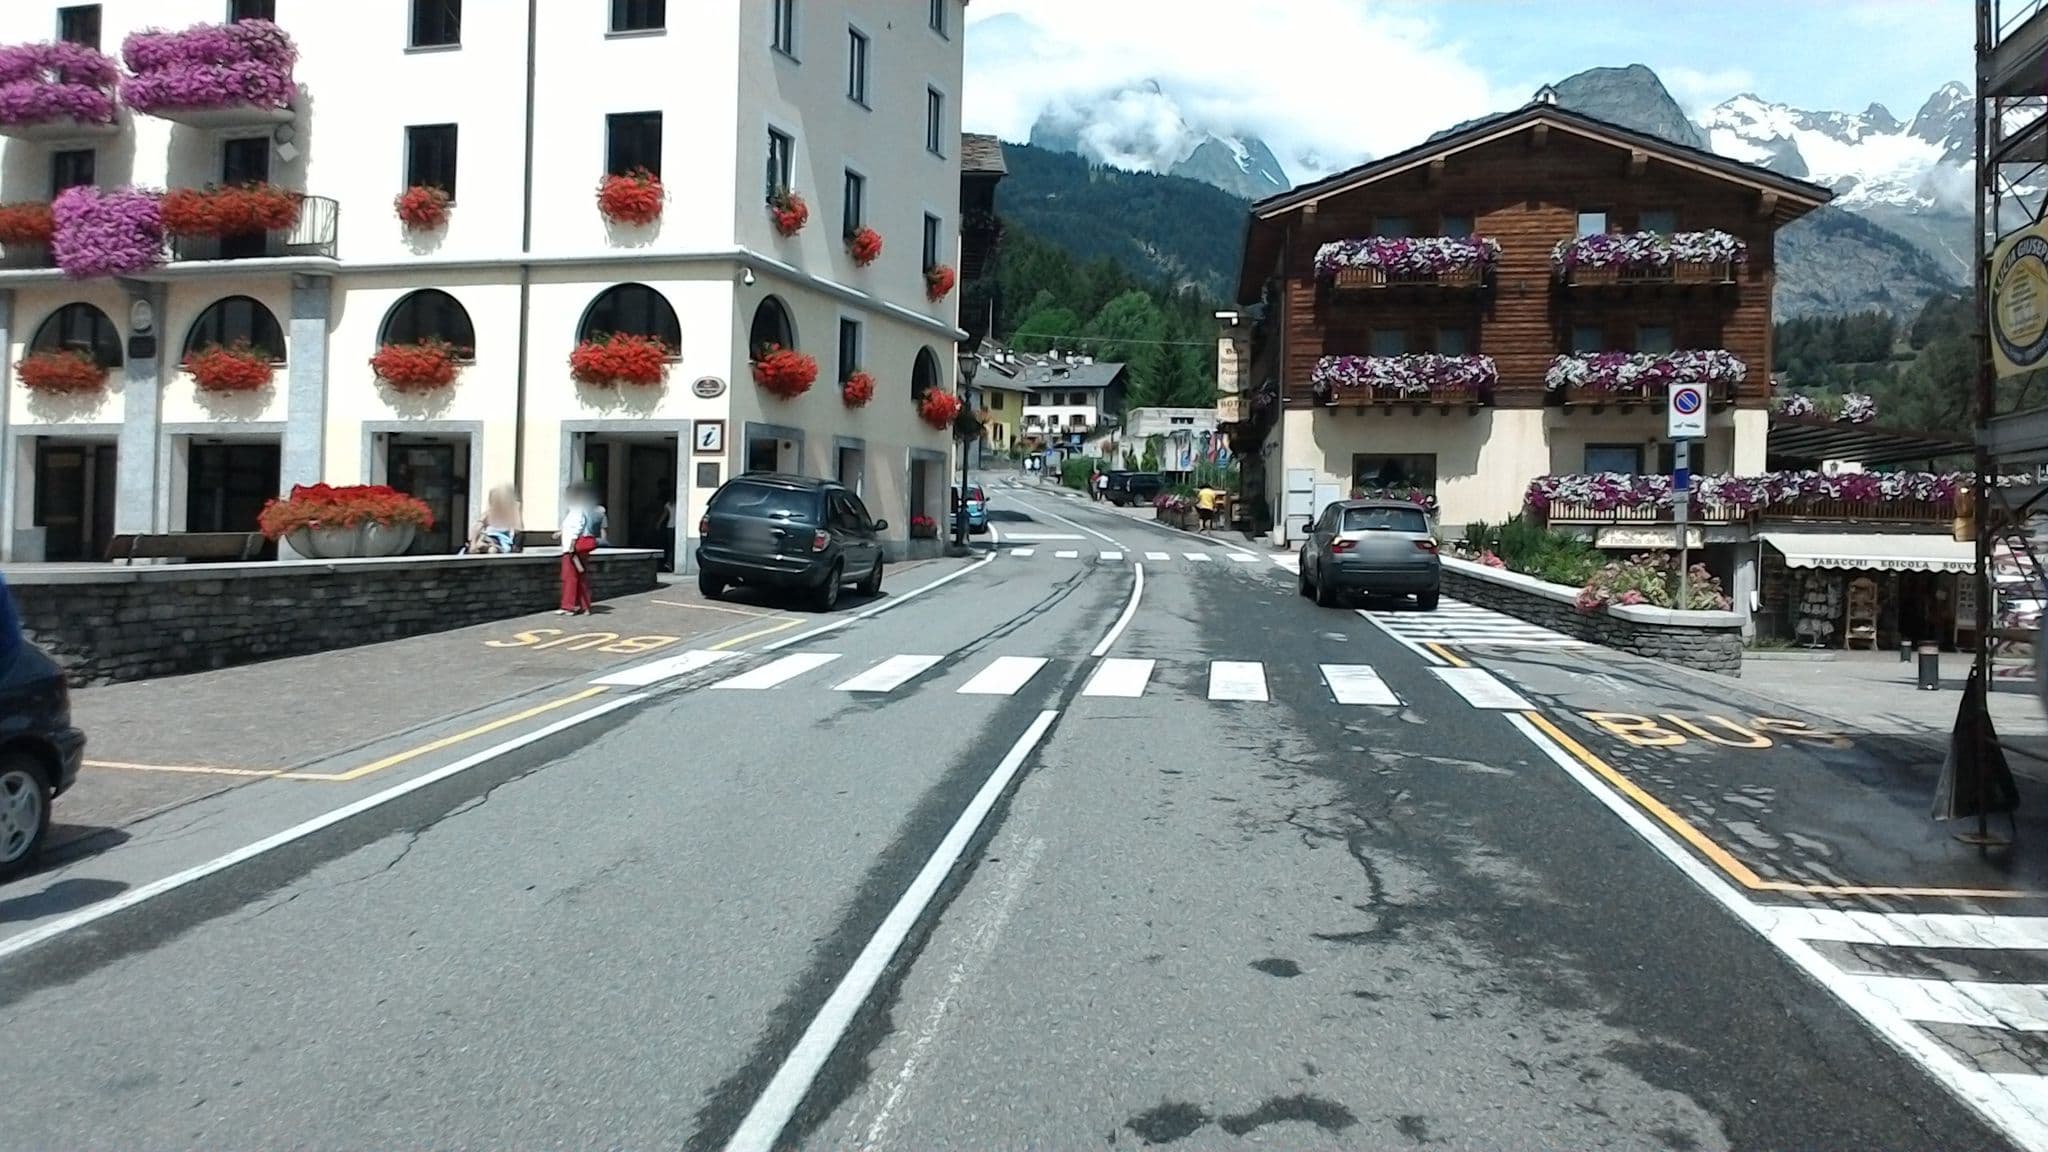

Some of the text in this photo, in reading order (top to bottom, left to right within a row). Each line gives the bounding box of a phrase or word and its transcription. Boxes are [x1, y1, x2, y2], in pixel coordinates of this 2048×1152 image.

[1811, 558, 1868, 567] TABACCHI
[1881, 560, 1930, 569] EDICOLA
[484, 628, 681, 654] BUS
[1579, 711, 1853, 749] BUS
